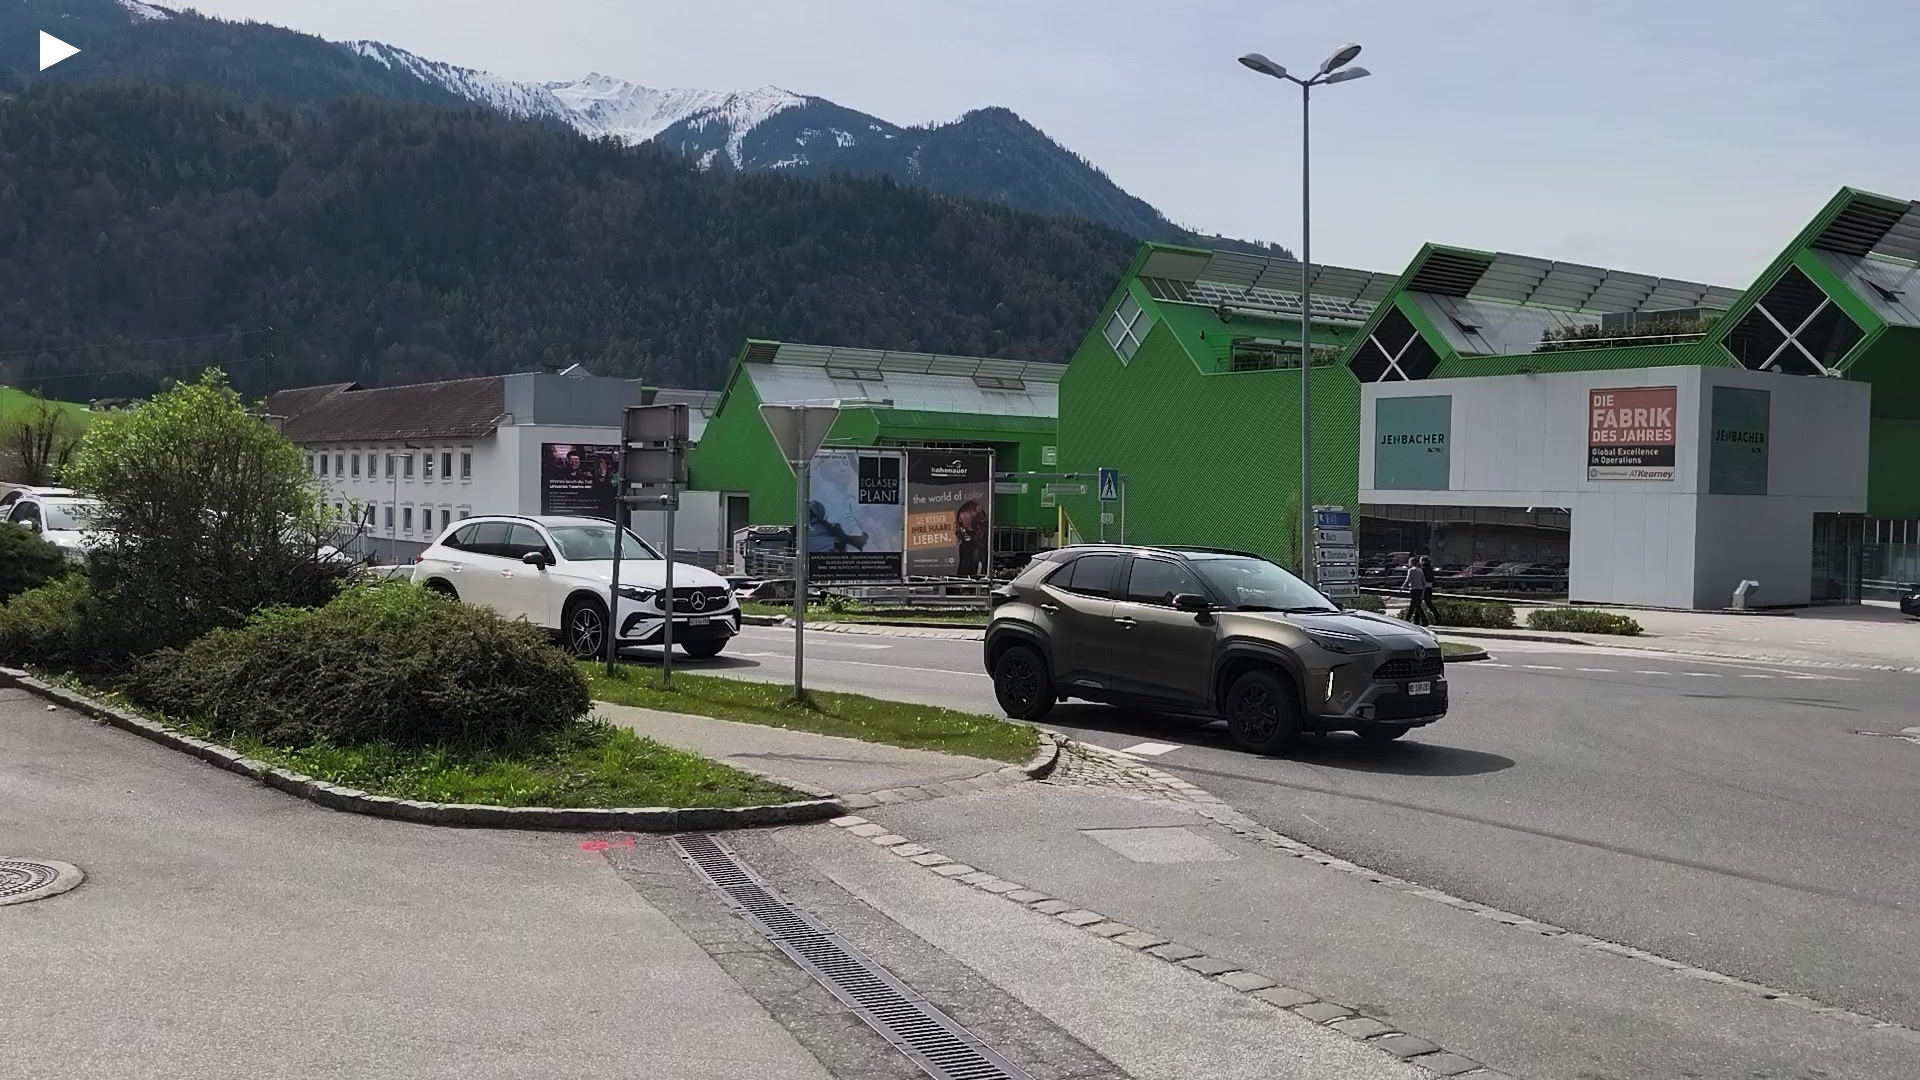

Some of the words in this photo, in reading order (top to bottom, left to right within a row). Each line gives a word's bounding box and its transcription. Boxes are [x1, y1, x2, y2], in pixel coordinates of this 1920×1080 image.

[1594, 395, 1614, 407] DIE
[1593, 407, 1672, 428] FABRIK
[1381, 433, 1445, 445] JENBACHER
[1593, 430, 1617, 442] DES
[1620, 429, 1672, 442] JAHRES
[1716, 430, 1765, 443] JENBACHER
[1592, 448, 1616, 456] Global
[1618, 448, 1659, 456] Excellence
[1592, 456, 1599, 464] in
[1601, 456, 1642, 465] Operations
[931, 466, 968, 474] hohenauer
[864, 478, 898, 488] GLASER
[860, 489, 897, 503] PLANT
[913, 494, 926, 504] the
[928, 491, 952, 503] world
[954, 490, 962, 501] of
[964, 490, 983, 500] color
[912, 526, 927, 534] IHRE
[928, 524, 952, 533] HAARE
[913, 533, 952, 545] LIEBEN.
